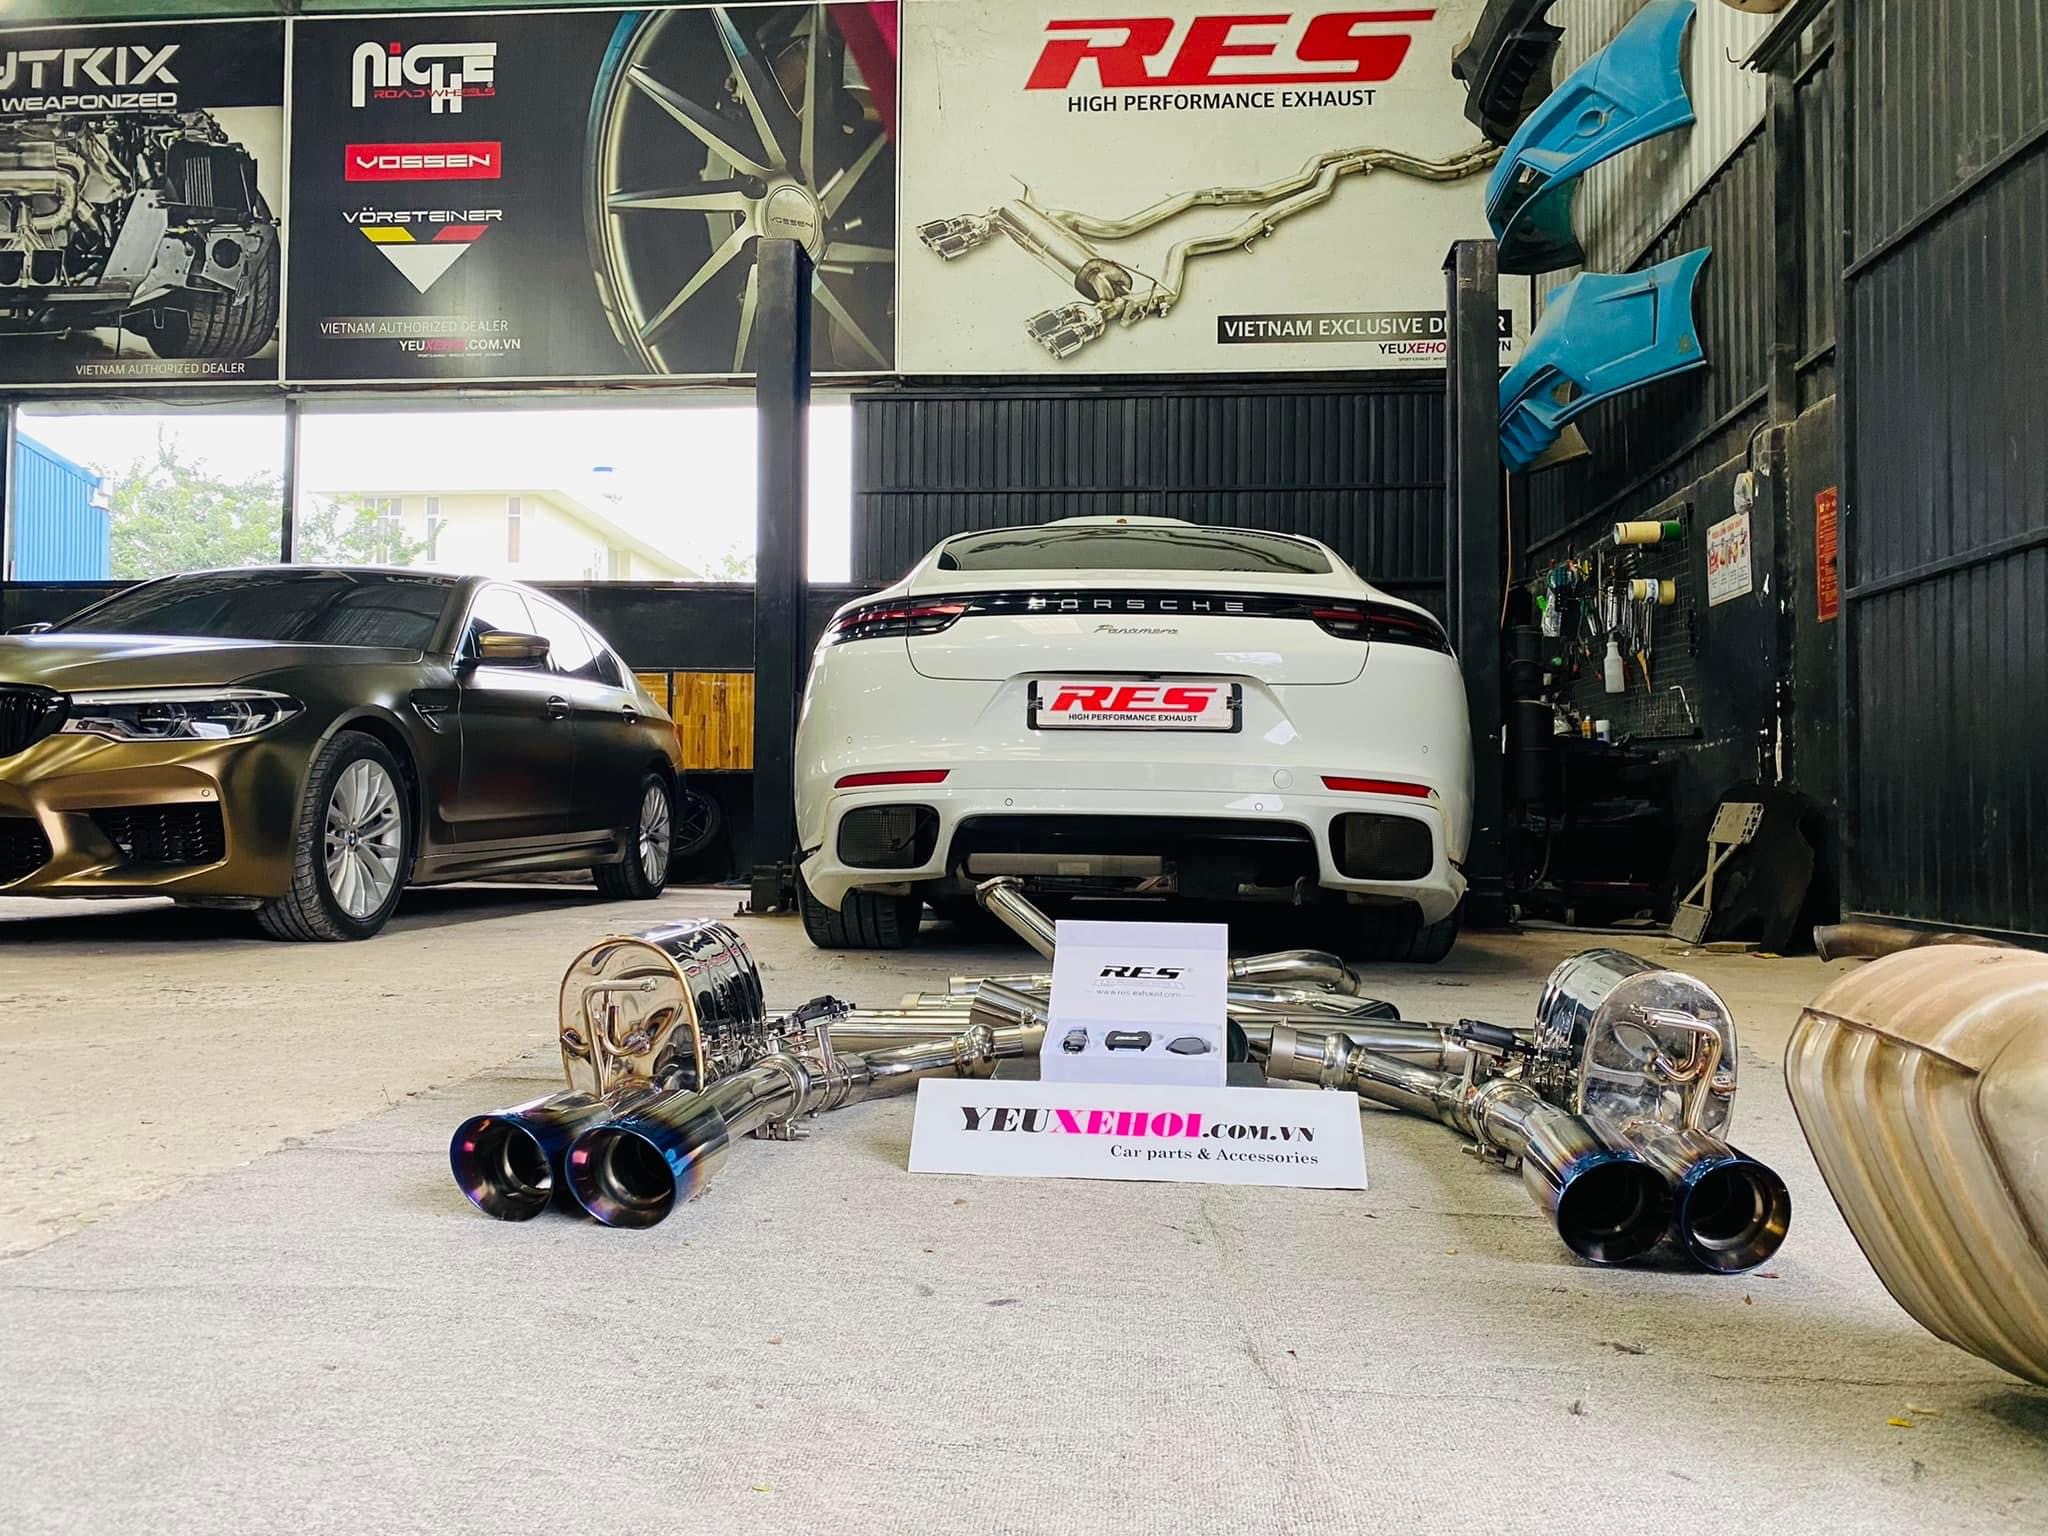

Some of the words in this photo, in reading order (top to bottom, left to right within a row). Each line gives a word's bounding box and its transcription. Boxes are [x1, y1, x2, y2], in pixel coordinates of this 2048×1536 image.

[1024, 8, 1437, 90] RES
[373, 89, 425, 99] ROAD
[428, 87, 496, 98] WHEELS
[1067, 95, 1119, 113] HIGH
[1123, 91, 1275, 112] PERFORMANCE
[1282, 89, 1376, 108] EXHAUST
[2, 92, 178, 112] WEAPONIZED
[356, 153, 491, 169] VOSSEN
[342, 206, 503, 224] VÖRSTEINER
[320, 322, 375, 335] VIETNAM
[379, 321, 457, 334] AUTHORIZED
[463, 319, 509, 333] DEALER
[1224, 319, 1313, 338] VIETNAM
[1319, 316, 1423, 336] EXCLUSIVE
[399, 338, 521, 352] YEUXE.COM.VN
[75, 364, 125, 376] VIETNAM
[128, 363, 199, 376] AUTHORIZED
[202, 362, 246, 374] DEALER
[1028, 597, 1244, 612] PORSCHE
[1094, 624, 1179, 635] Panamera
[1050, 685, 1218, 713] RES
[1068, 713, 1090, 721] HIGH
[1091, 713, 1157, 722] PERFORMANCE
[1158, 714, 1198, 722] EXHAUST
[1100, 965, 1185, 980] RES
[960, 1106, 1315, 1142] YEUXEHOI.COM.VN
[1110, 1144, 1143, 1159] Car
[1147, 1146, 1193, 1162] parts
[1199, 1147, 1211, 1161] &
[1216, 1148, 1319, 1166] Accessories
